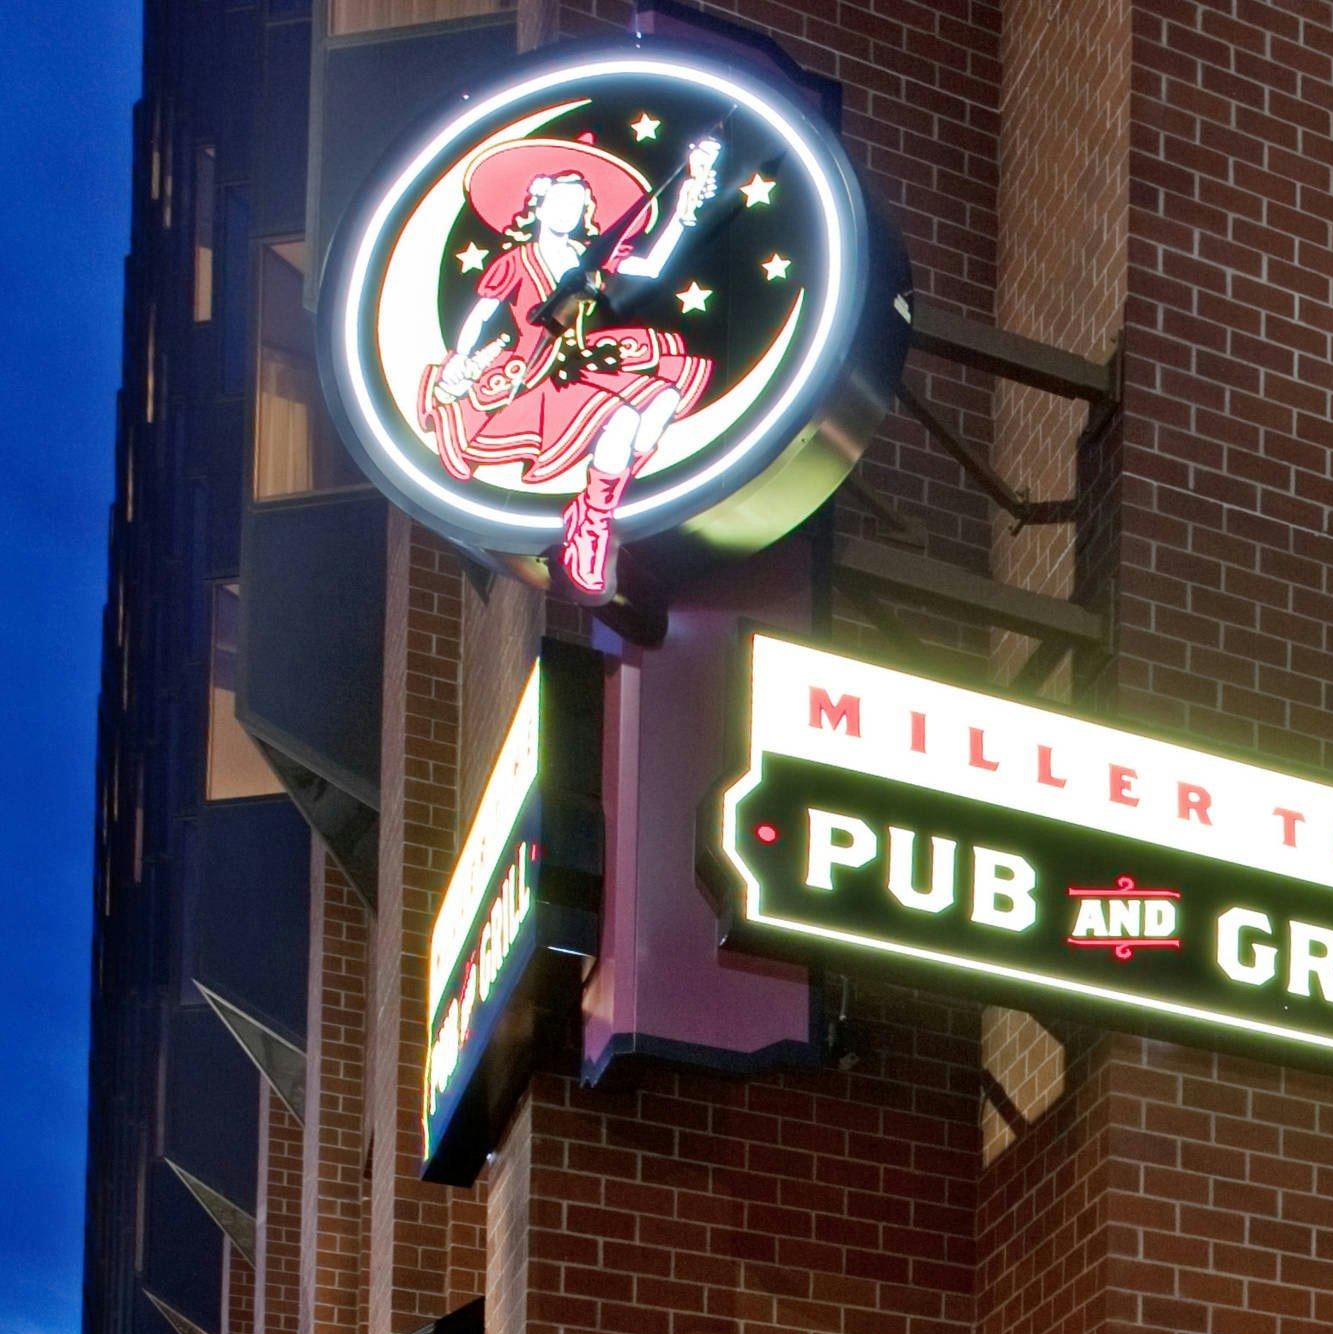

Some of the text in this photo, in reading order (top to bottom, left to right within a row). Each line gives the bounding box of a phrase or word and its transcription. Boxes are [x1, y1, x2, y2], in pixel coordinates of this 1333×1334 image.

[808, 685, 1213, 827] MILLER
[805, 808, 1038, 935] PUB
[1071, 896, 1178, 941] AND
